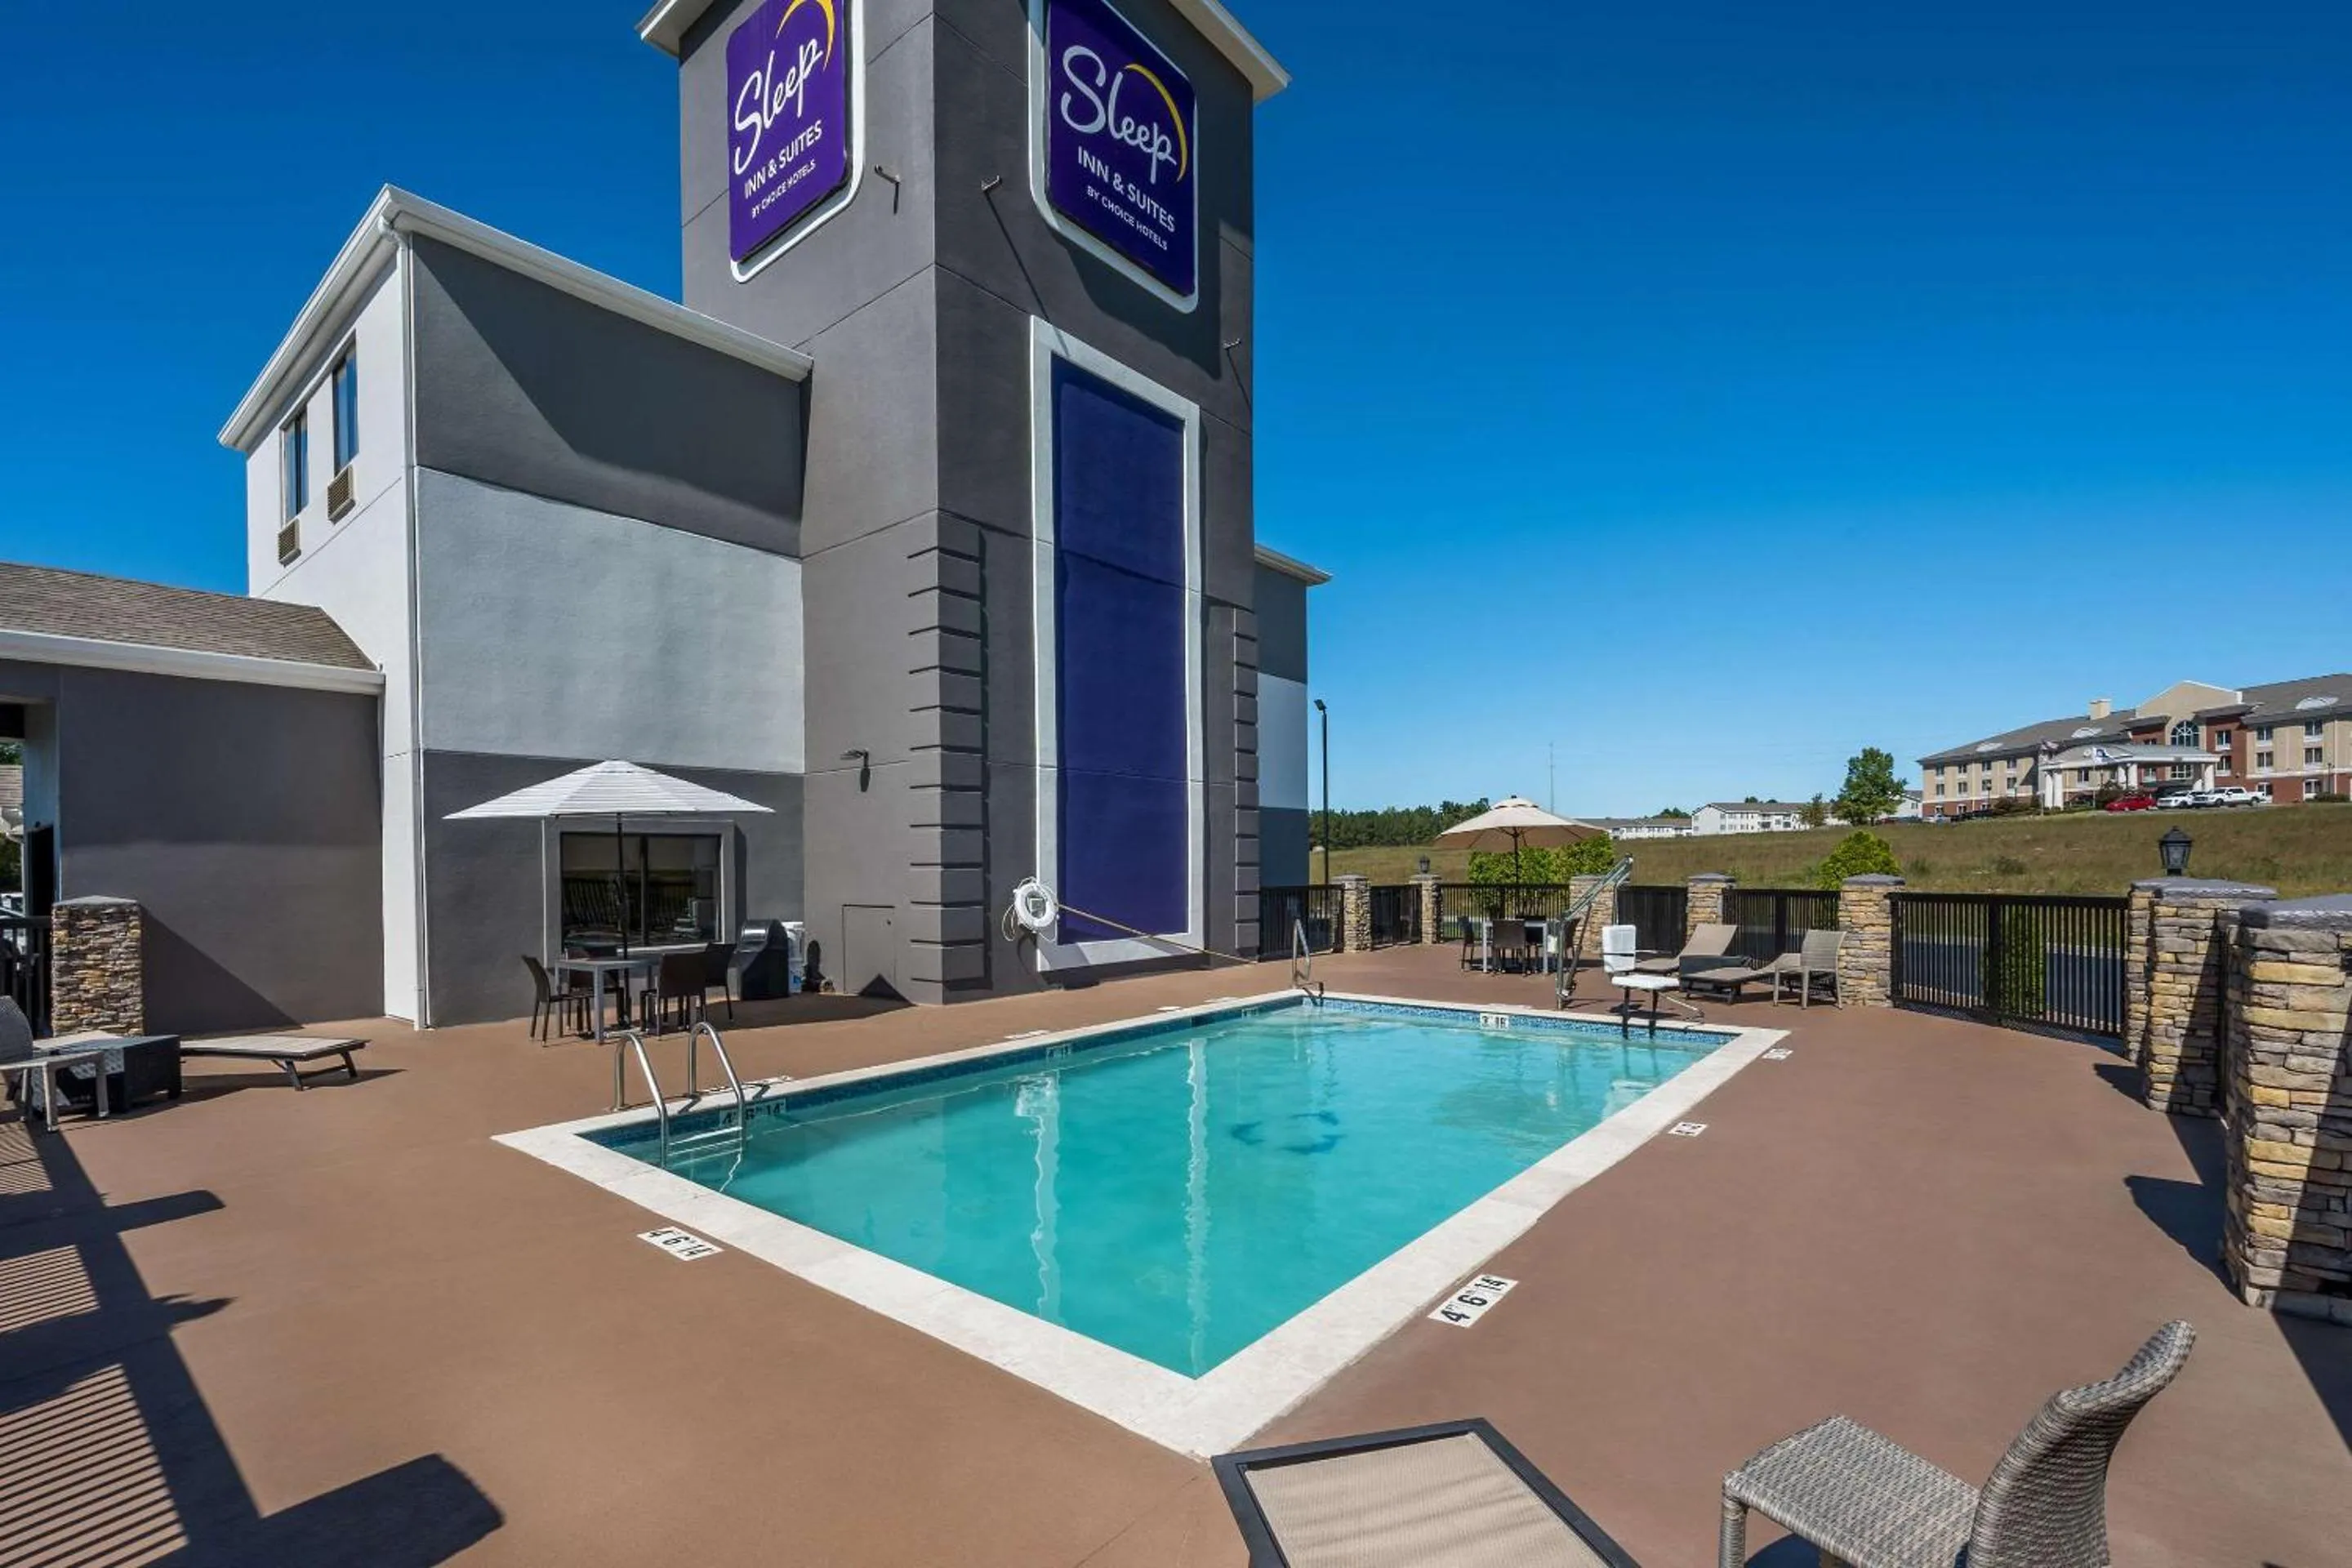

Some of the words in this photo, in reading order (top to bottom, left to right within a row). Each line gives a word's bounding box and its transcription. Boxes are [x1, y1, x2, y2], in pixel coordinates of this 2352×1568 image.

[734, 38, 823, 176] Sleep
[1061, 45, 1178, 185] Sleep
[744, 166, 766, 199] INN
[768, 158, 777, 179] &
[779, 119, 822, 169] SUITES
[751, 203, 760, 219] BY
[761, 180, 786, 209] CHOICE
[786, 158, 816, 189] HOTELS
[1078, 145, 1109, 183] INN
[1113, 172, 1125, 195] &
[1127, 183, 1175, 233] SUITES
[1087, 185, 1100, 200] BY
[1102, 196, 1135, 227] CHOICE
[1136, 220, 1167, 251] HOTELS
